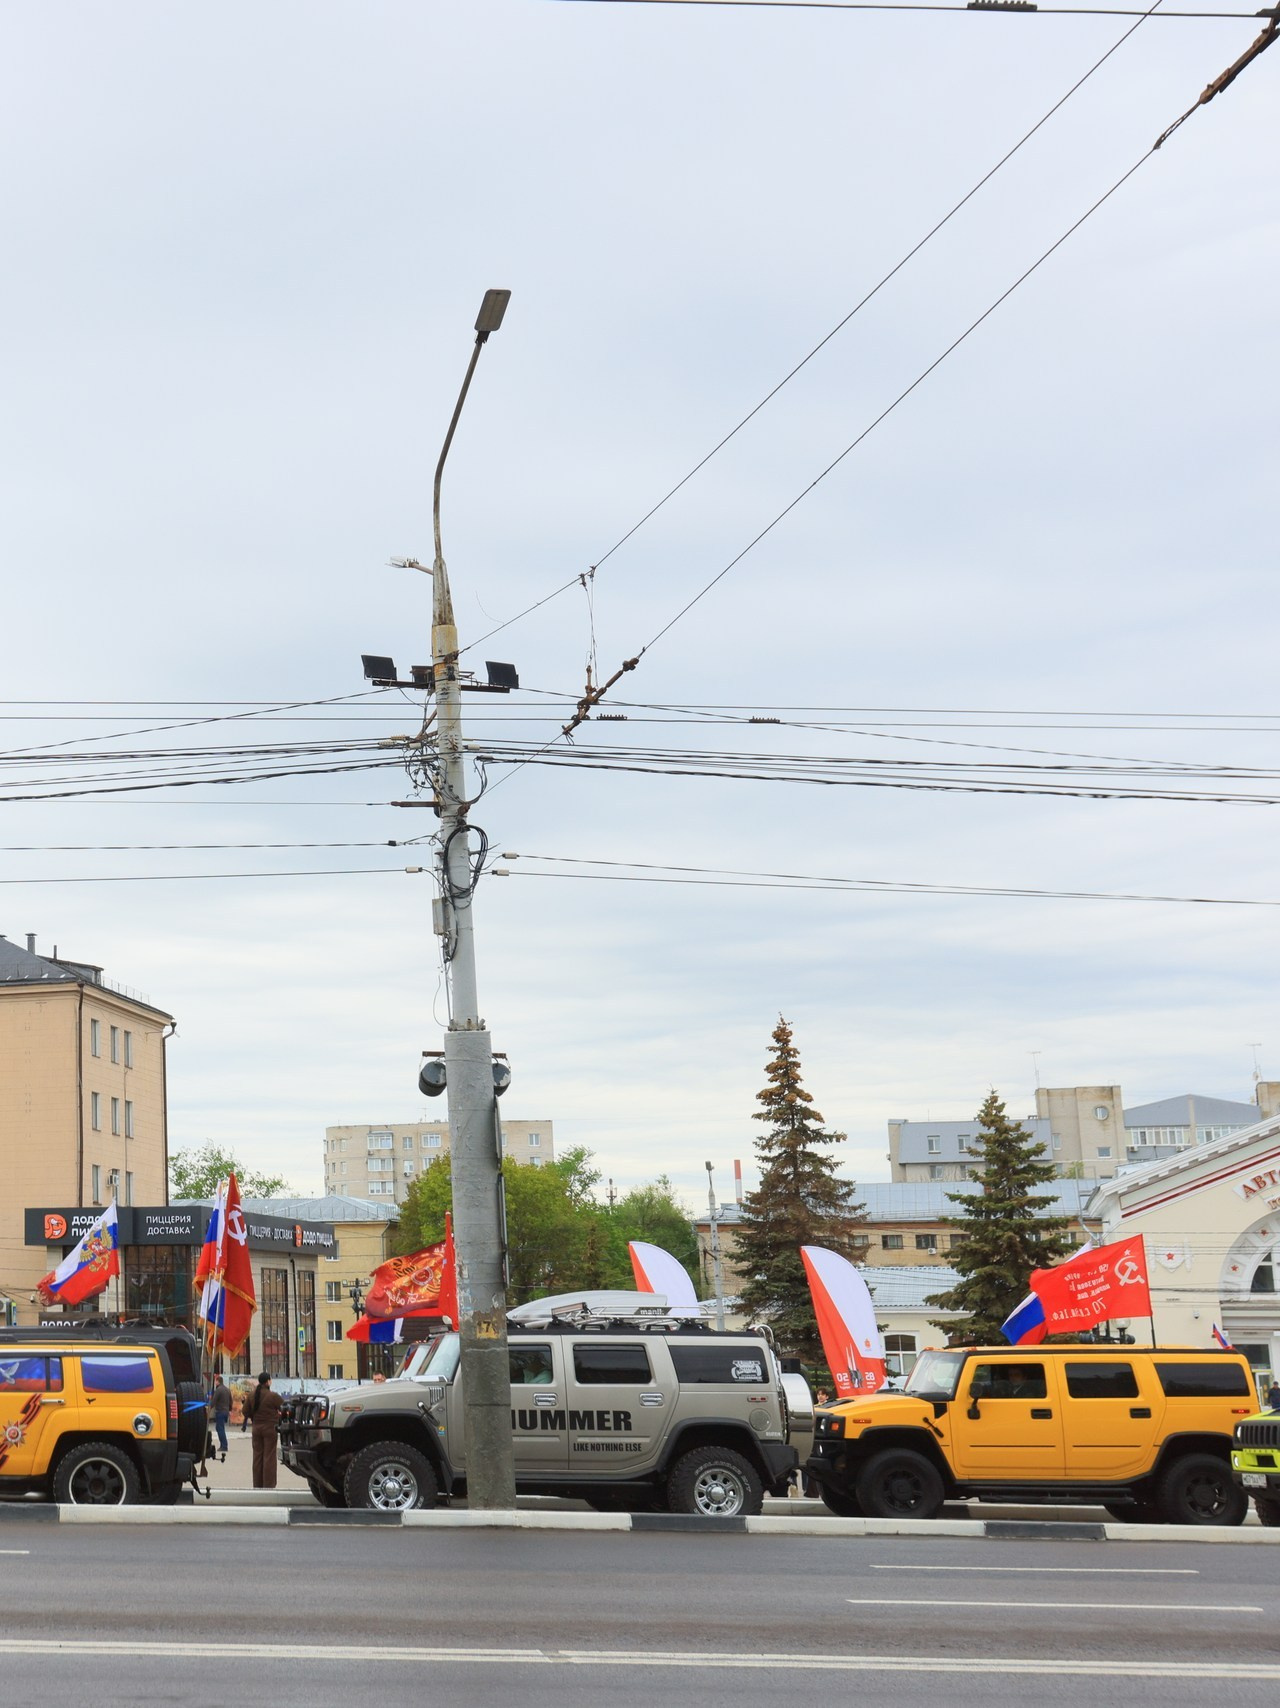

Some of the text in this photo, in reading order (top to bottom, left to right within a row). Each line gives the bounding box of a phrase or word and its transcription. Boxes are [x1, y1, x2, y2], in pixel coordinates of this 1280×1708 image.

[1242, 1169, 1280, 1198] АВТ
[145, 1215, 192, 1225] ПИЦЦЕРИЯ
[146, 1226, 191, 1236] ДОСТАВКА
[249, 1224, 271, 1239] ПИЦЦЕРИЯ
[573, 1442, 642, 1452] LIKE NOTHING ELSE
